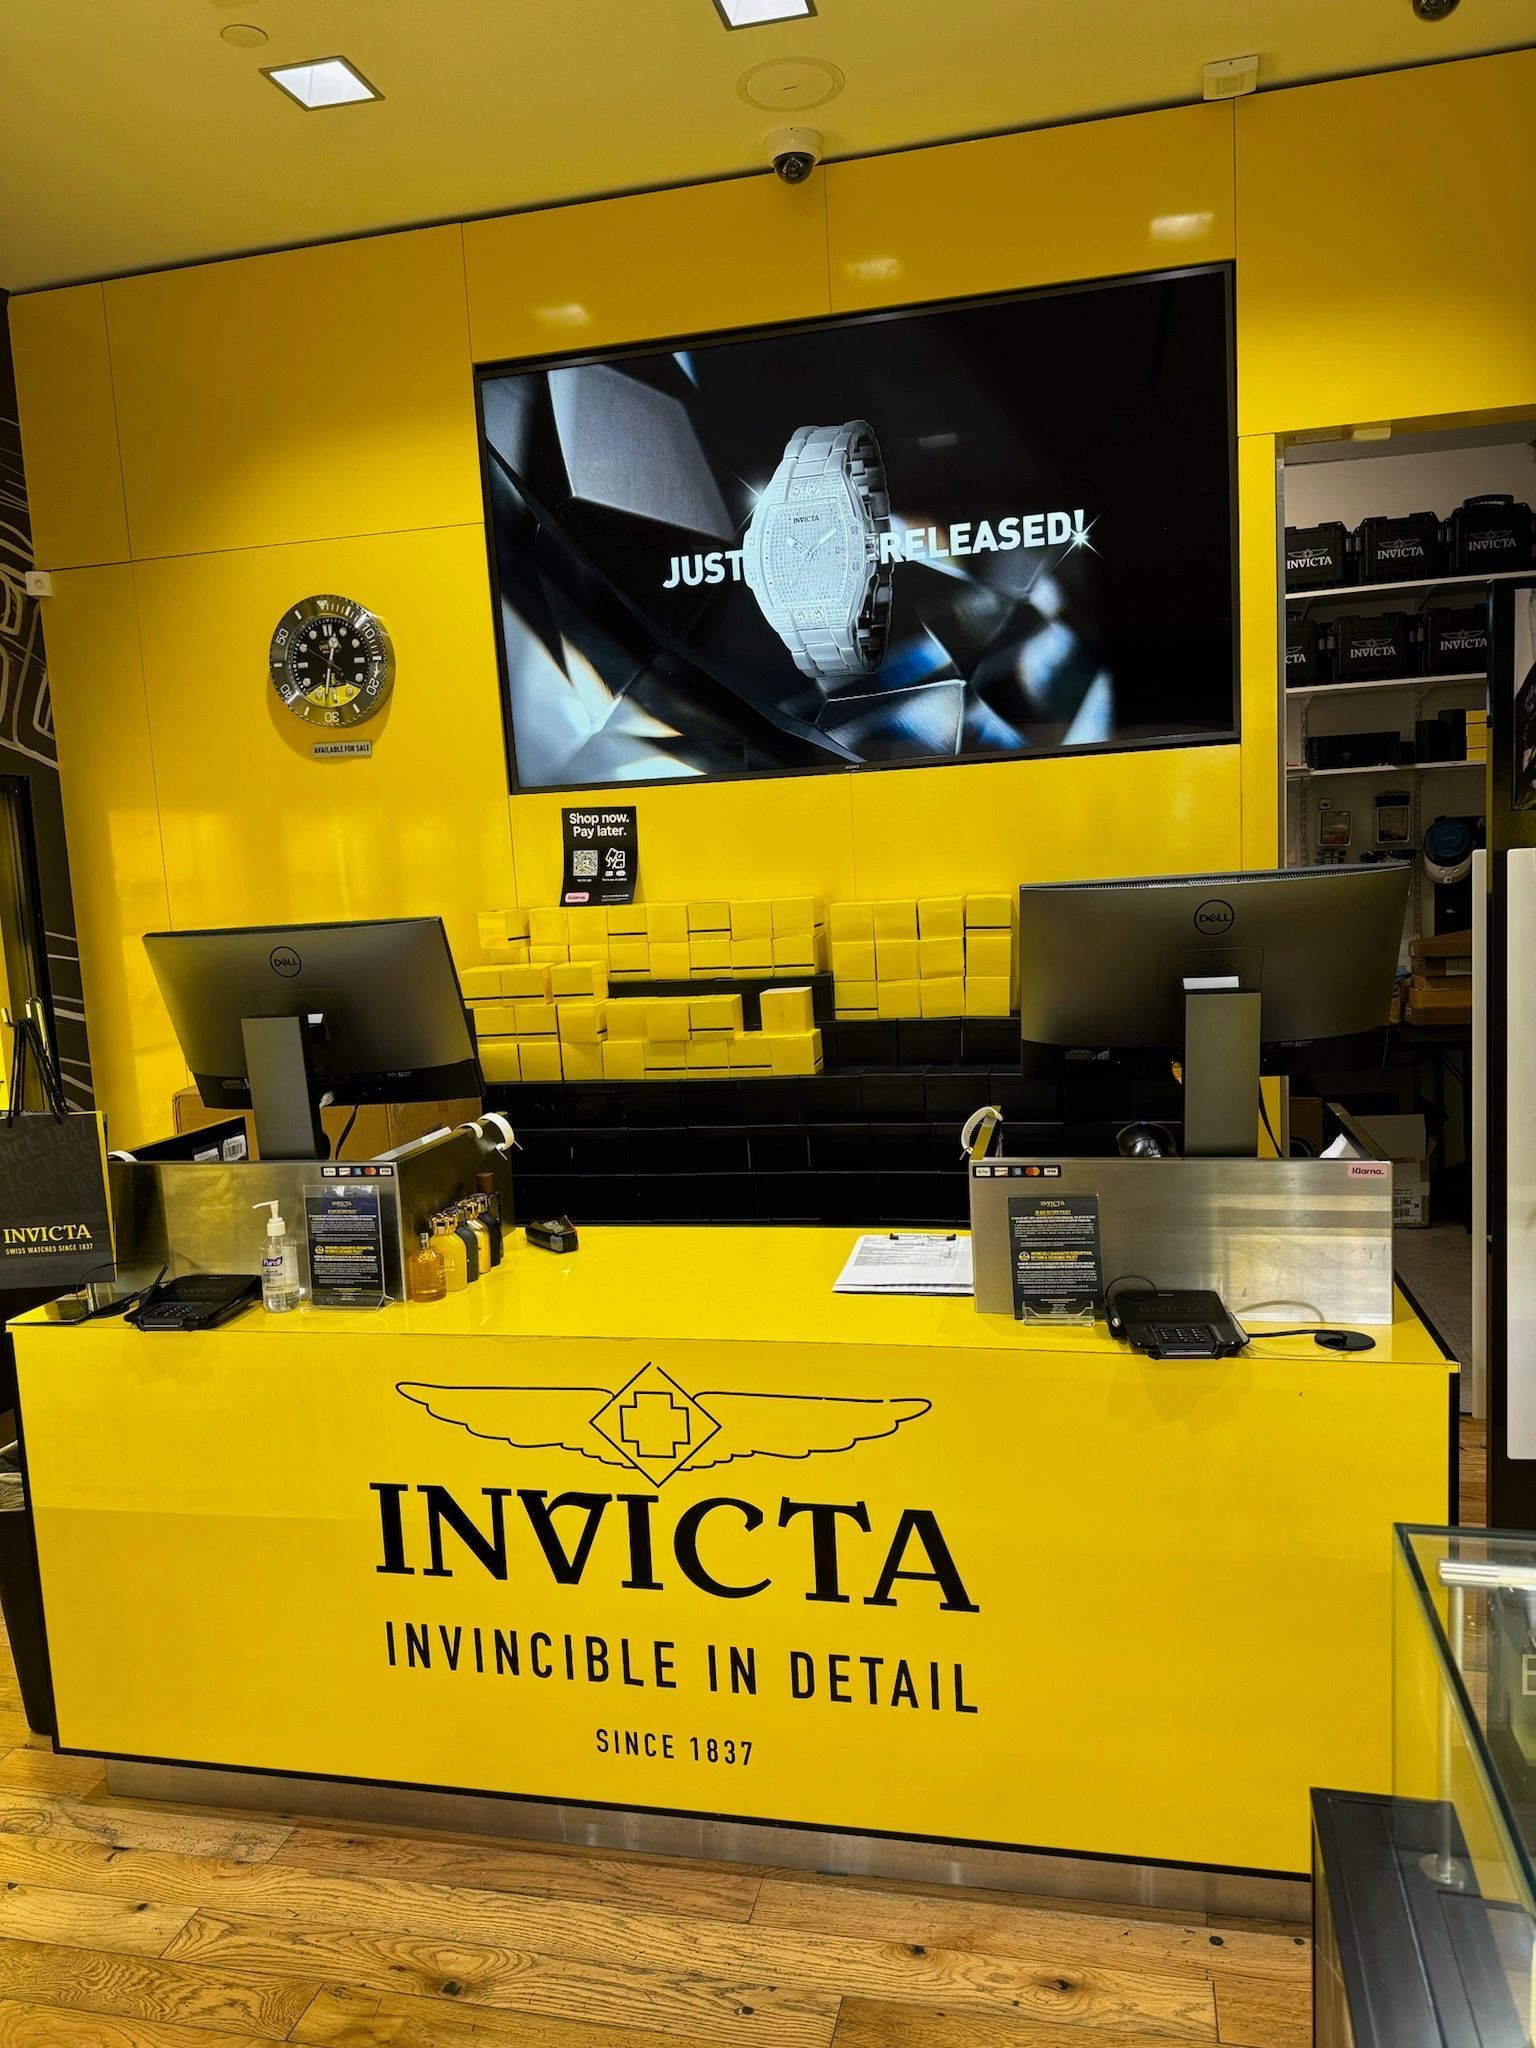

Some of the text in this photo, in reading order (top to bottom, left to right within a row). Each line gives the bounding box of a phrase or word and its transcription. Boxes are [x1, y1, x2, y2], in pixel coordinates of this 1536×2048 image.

[794, 515, 820, 524] INVICTA
[662, 509, 1086, 589] JUST RELEASED!
[1469, 537, 1517, 551] INVICTA
[1377, 546, 1424, 560] INVICTA
[1286, 556, 1333, 570] INVICTA
[275, 628, 289, 646] 50
[1440, 638, 1488, 651] INVICTA
[1350, 646, 1396, 659] INVICTA
[325, 711, 340, 723] 30
[313, 744, 370, 755] AVAILABLE FOR SALE
[569, 813, 629, 826] Shop now.
[573, 825, 627, 840] Pay later.
[1200, 913, 1231, 923] DELL
[273, 958, 299, 967] DELL
[1352, 1167, 1384, 1175] Klarna.
[2, 1224, 93, 1245] INVICTA
[5, 1242, 94, 1256] SWISS WATCHES SINCE 1837
[369, 1481, 981, 1614] INVICTA
[385, 1621, 979, 1714] INVINCIBLE IN DETAIL
[595, 1729, 753, 1766] SINCE 1837
